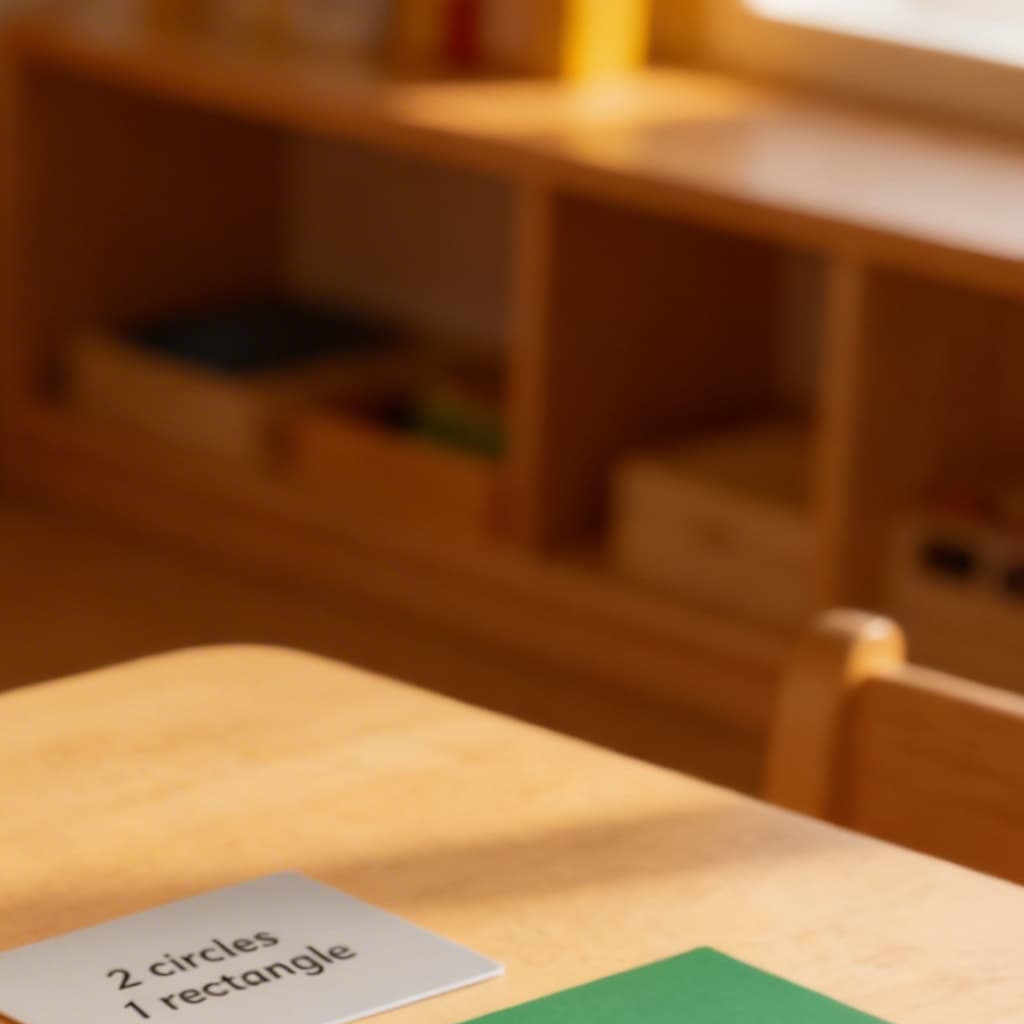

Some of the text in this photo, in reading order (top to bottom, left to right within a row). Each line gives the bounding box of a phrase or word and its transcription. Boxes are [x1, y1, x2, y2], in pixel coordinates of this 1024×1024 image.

[106, 932, 280, 992] 2 circles
[123, 945, 356, 1020] 1 rectangle
